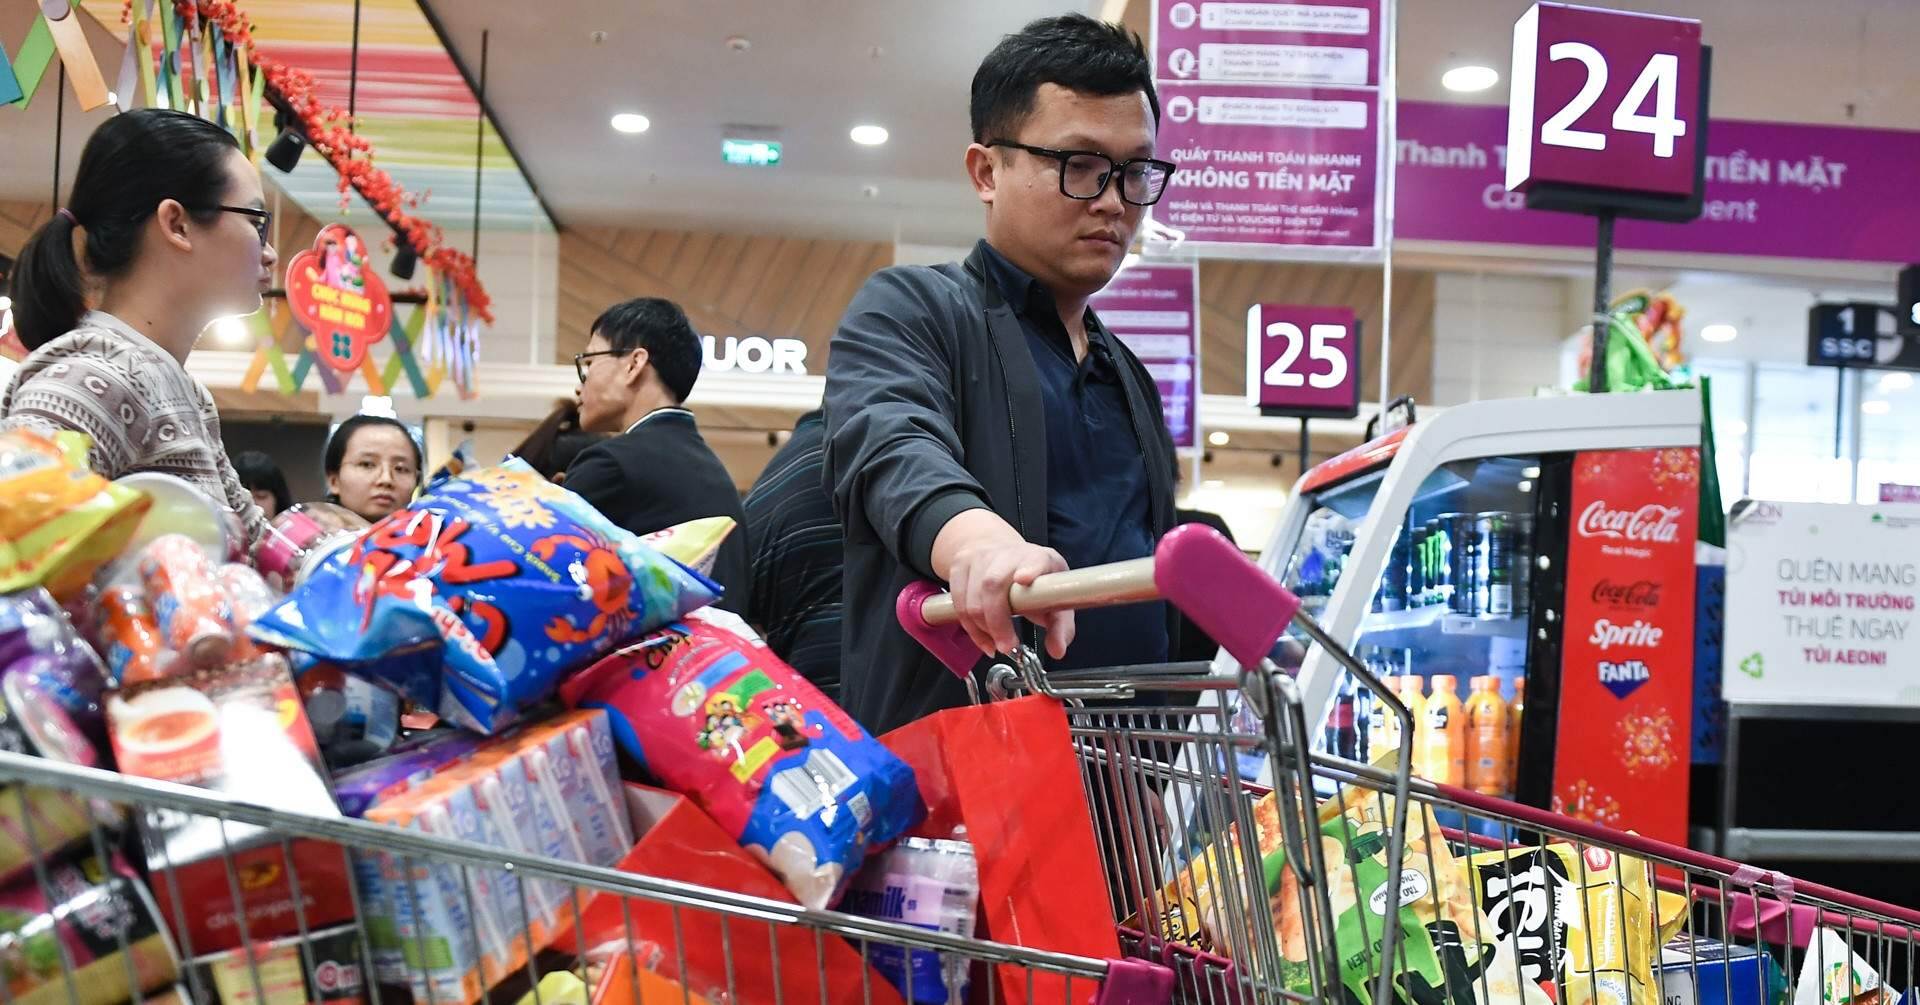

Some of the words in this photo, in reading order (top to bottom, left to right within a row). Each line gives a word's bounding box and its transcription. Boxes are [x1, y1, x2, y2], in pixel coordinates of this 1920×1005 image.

[1541, 42, 1686, 159] 24
[1214, 150, 1264, 164] THANH
[1268, 150, 1305, 165] TOÁN
[1308, 154, 1361, 167] NHANH
[1396, 138, 1487, 169] Thanh
[1170, 166, 1249, 188] KHÔNG
[1254, 167, 1304, 191] TIỀN
[1309, 171, 1355, 196] MẶT
[1777, 155, 1847, 193] MẶT
[1236, 214, 1283, 225] VOUCHER
[1838, 306, 1855, 334] 1
[702, 335, 808, 375] UOR
[1264, 322, 1348, 389] 25
[1821, 336, 1873, 360] SSC
[1578, 500, 1684, 543] Coca-Cola
[1778, 556, 1842, 583] QUÊN
[1850, 560, 1916, 586] MANG
[1591, 579, 1661, 607] Coca-Cola
[1778, 587, 1806, 605] TÚI
[1810, 588, 1841, 608] MÔI
[1845, 591, 1914, 611] TRƯỜNG
[1589, 619, 1664, 650] Sprite
[1784, 614, 1843, 640] THUÊ
[1851, 618, 1910, 641] NGAY
[1803, 644, 1831, 663] TÚI
[1835, 648, 1887, 666] AEON!
[1598, 660, 1650, 683] FANTA
